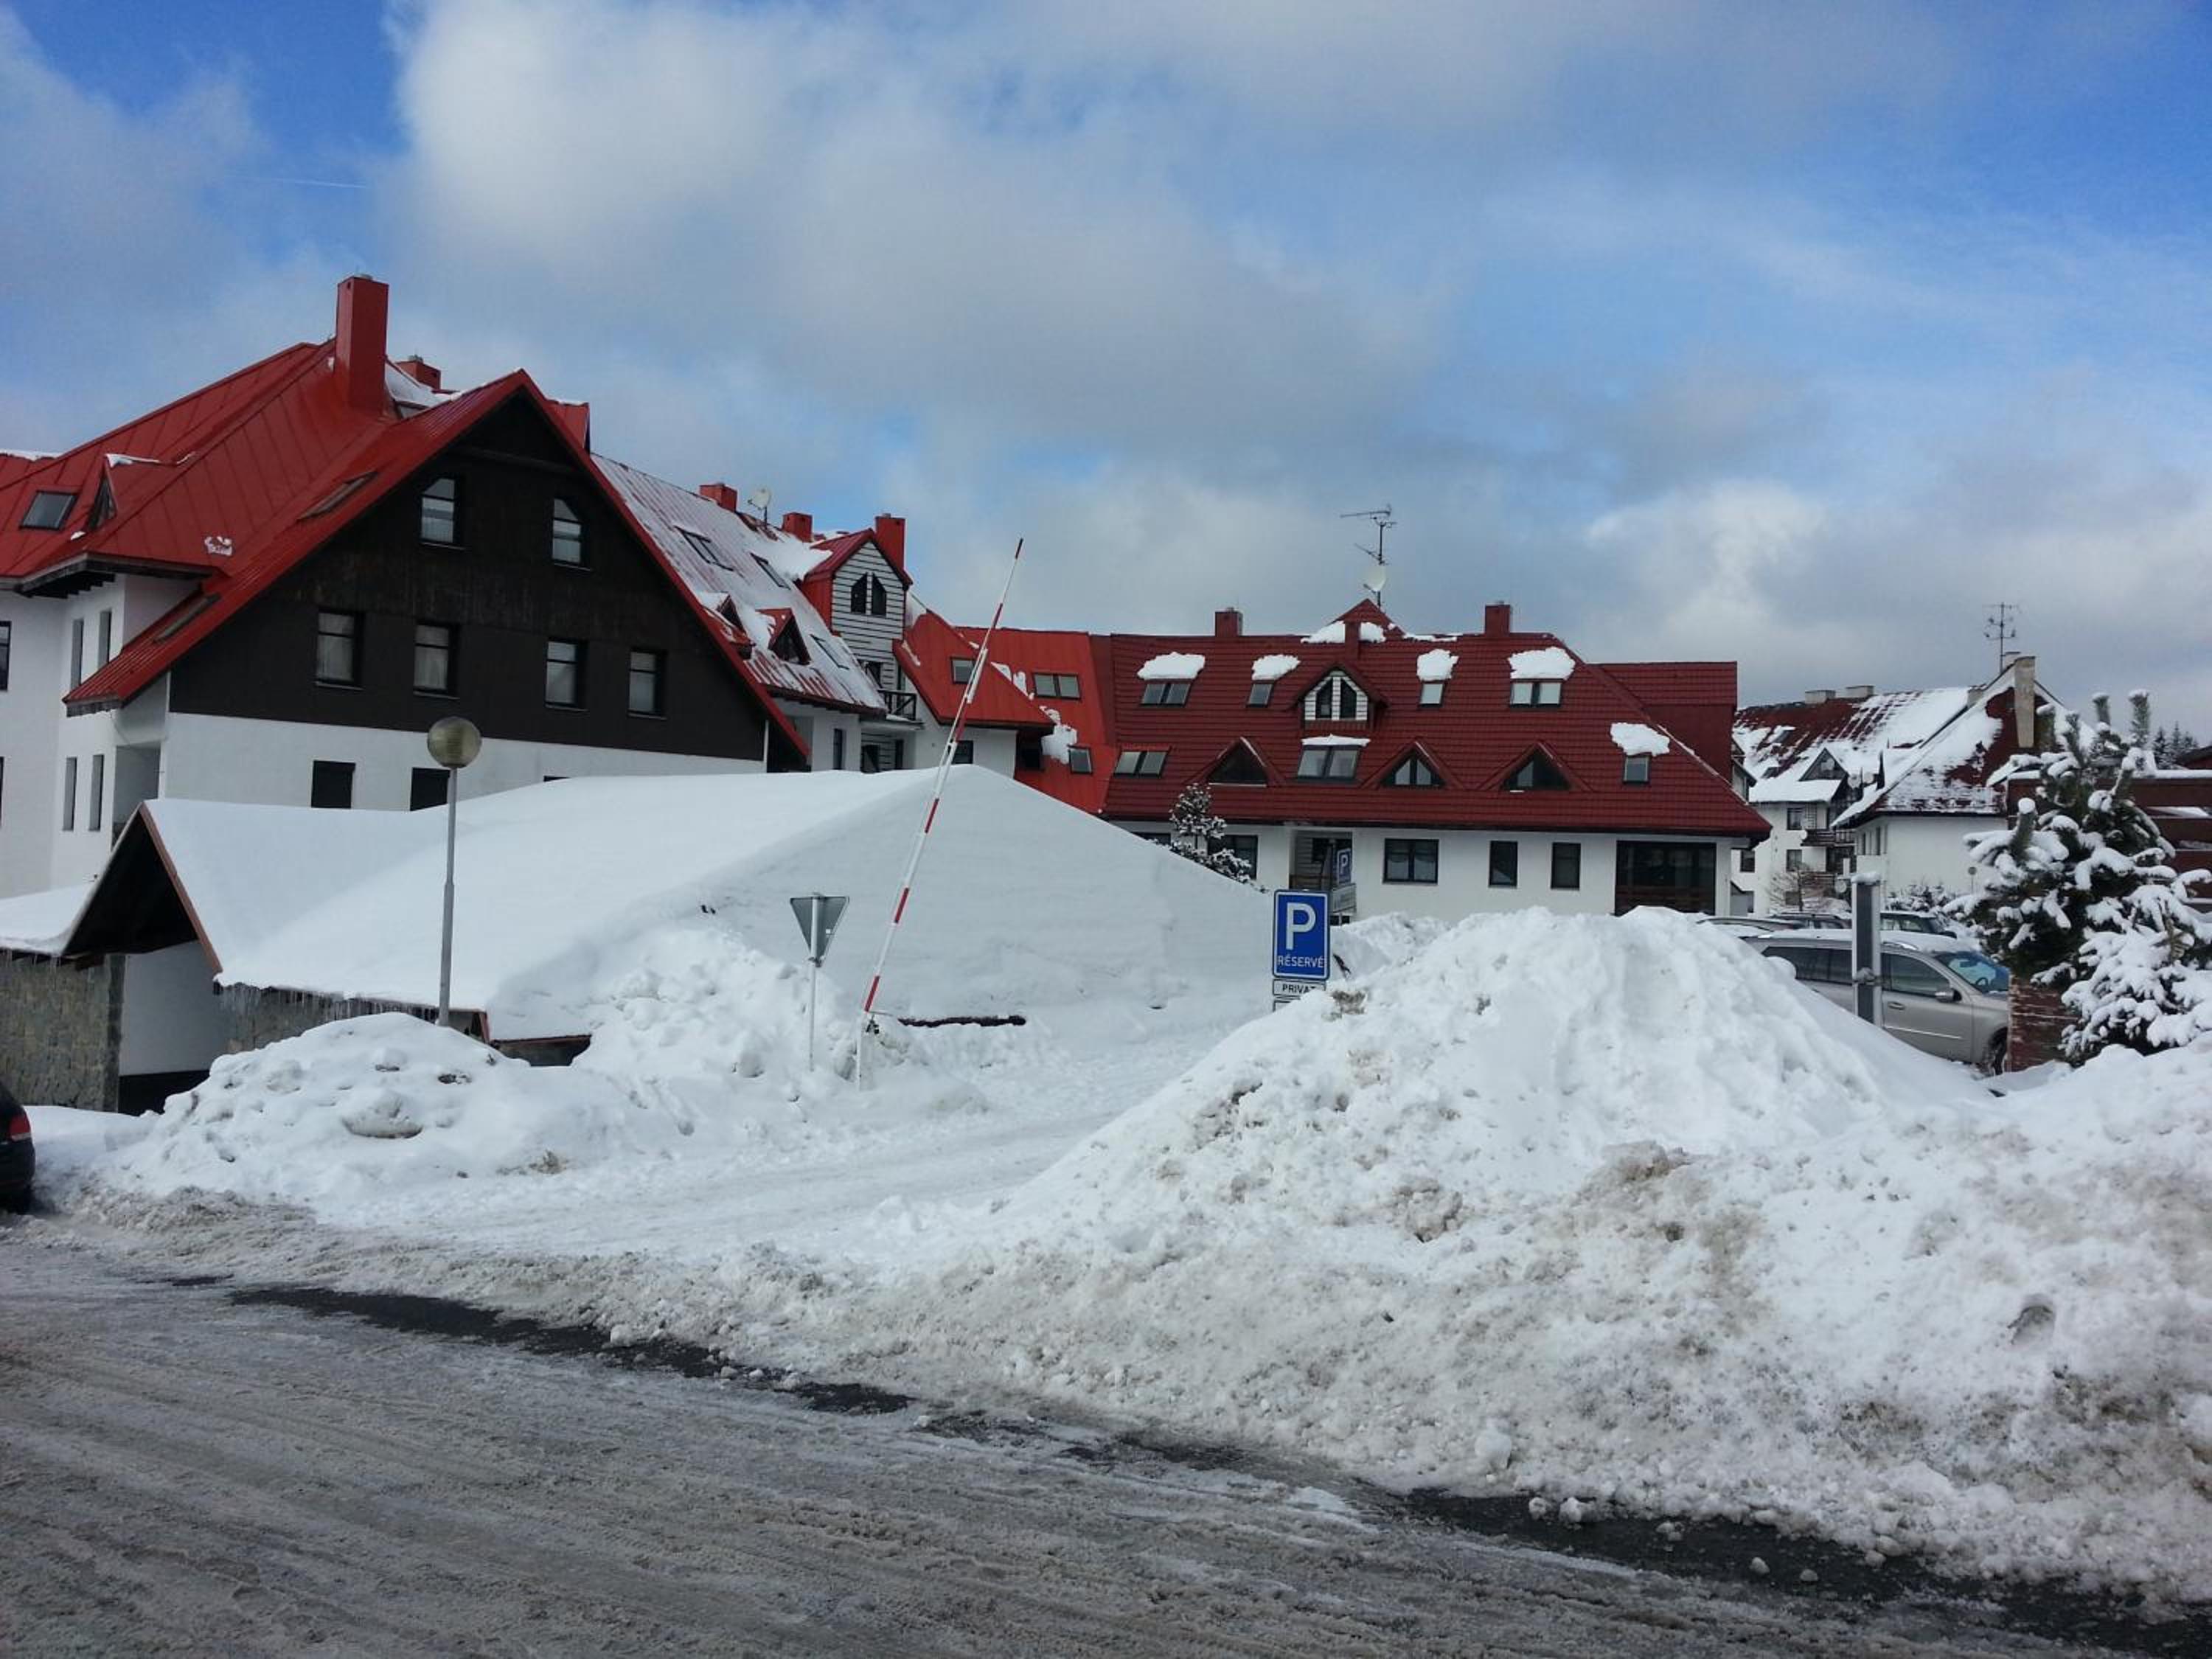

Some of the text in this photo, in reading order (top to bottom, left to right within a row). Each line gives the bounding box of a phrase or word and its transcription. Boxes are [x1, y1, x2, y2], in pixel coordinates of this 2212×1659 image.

[1340, 855, 1349, 874] P
[1285, 902, 1316, 950] P
[1278, 954, 1324, 968] RÉSERVÉ
